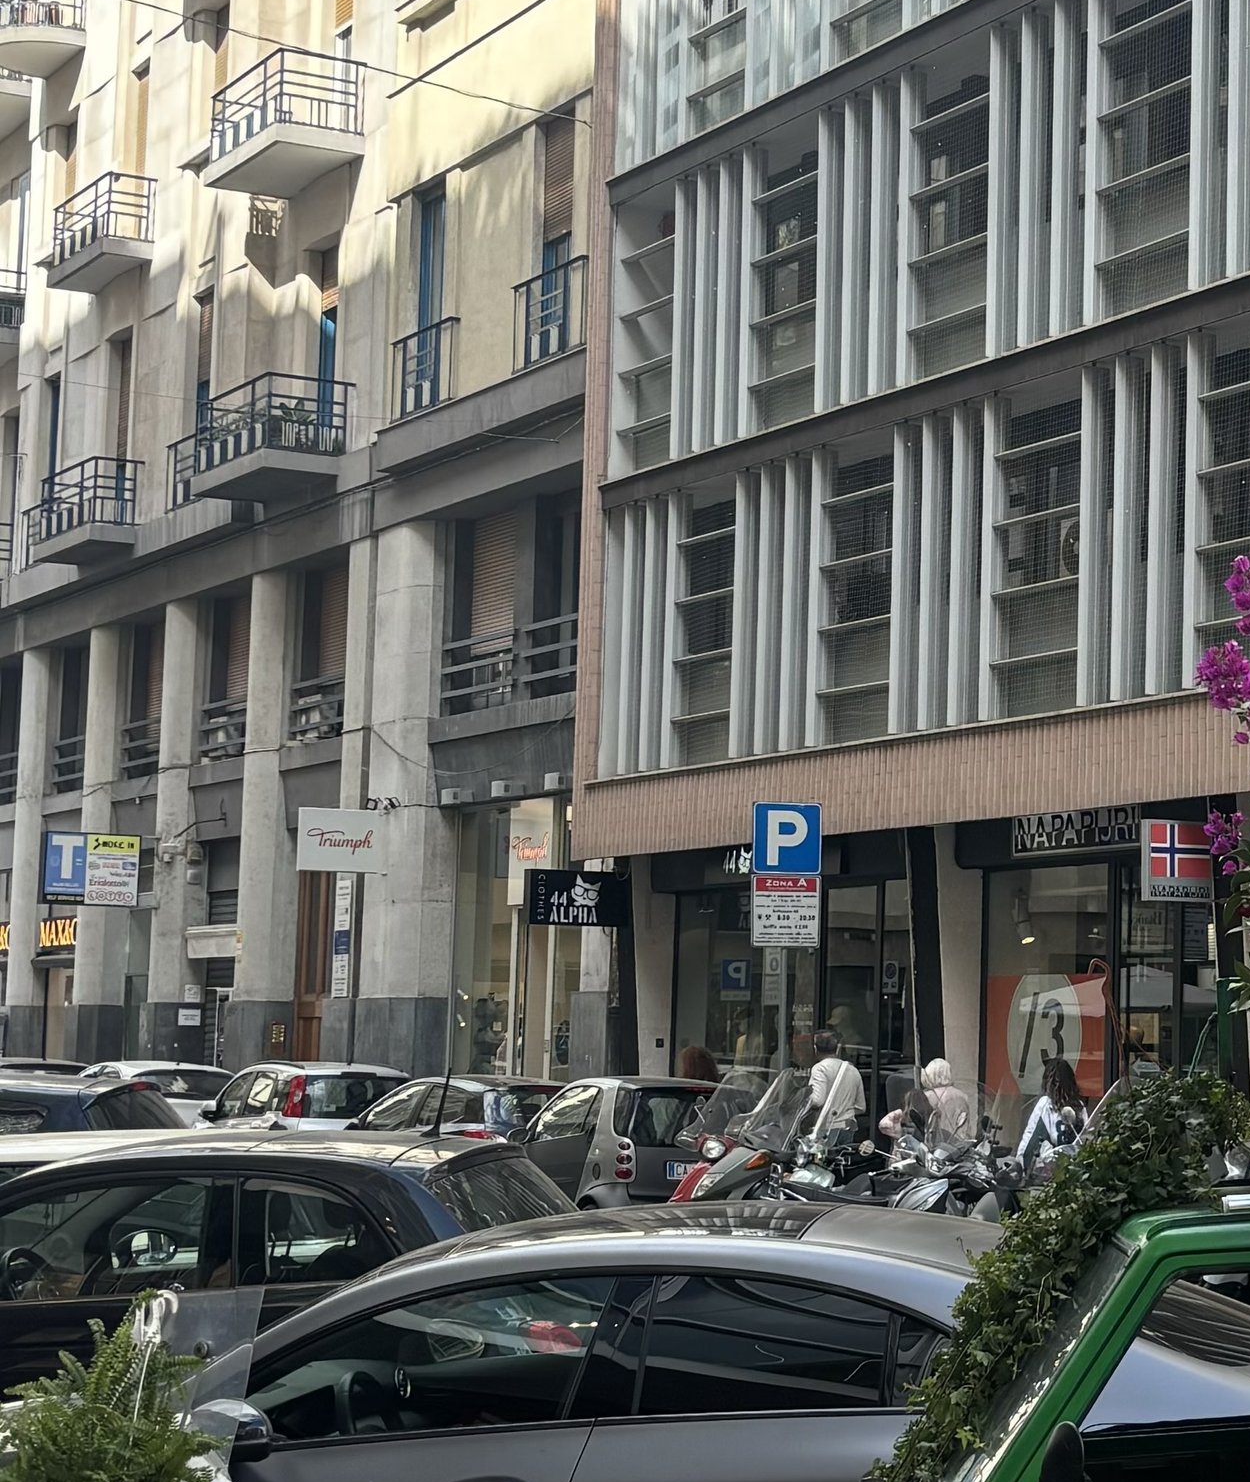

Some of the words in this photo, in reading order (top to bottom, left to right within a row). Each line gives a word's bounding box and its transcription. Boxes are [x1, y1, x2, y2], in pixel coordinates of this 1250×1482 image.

[306, 827, 374, 856] Triumph
[767, 810, 808, 866] P
[1015, 807, 1136, 849] NAPAPIJRI
[52, 835, 85, 879] T
[537, 874, 546, 920] CLOTHES
[550, 891, 567, 907] 44
[797, 878, 808, 887] A
[549, 906, 598, 924] ALPHA
